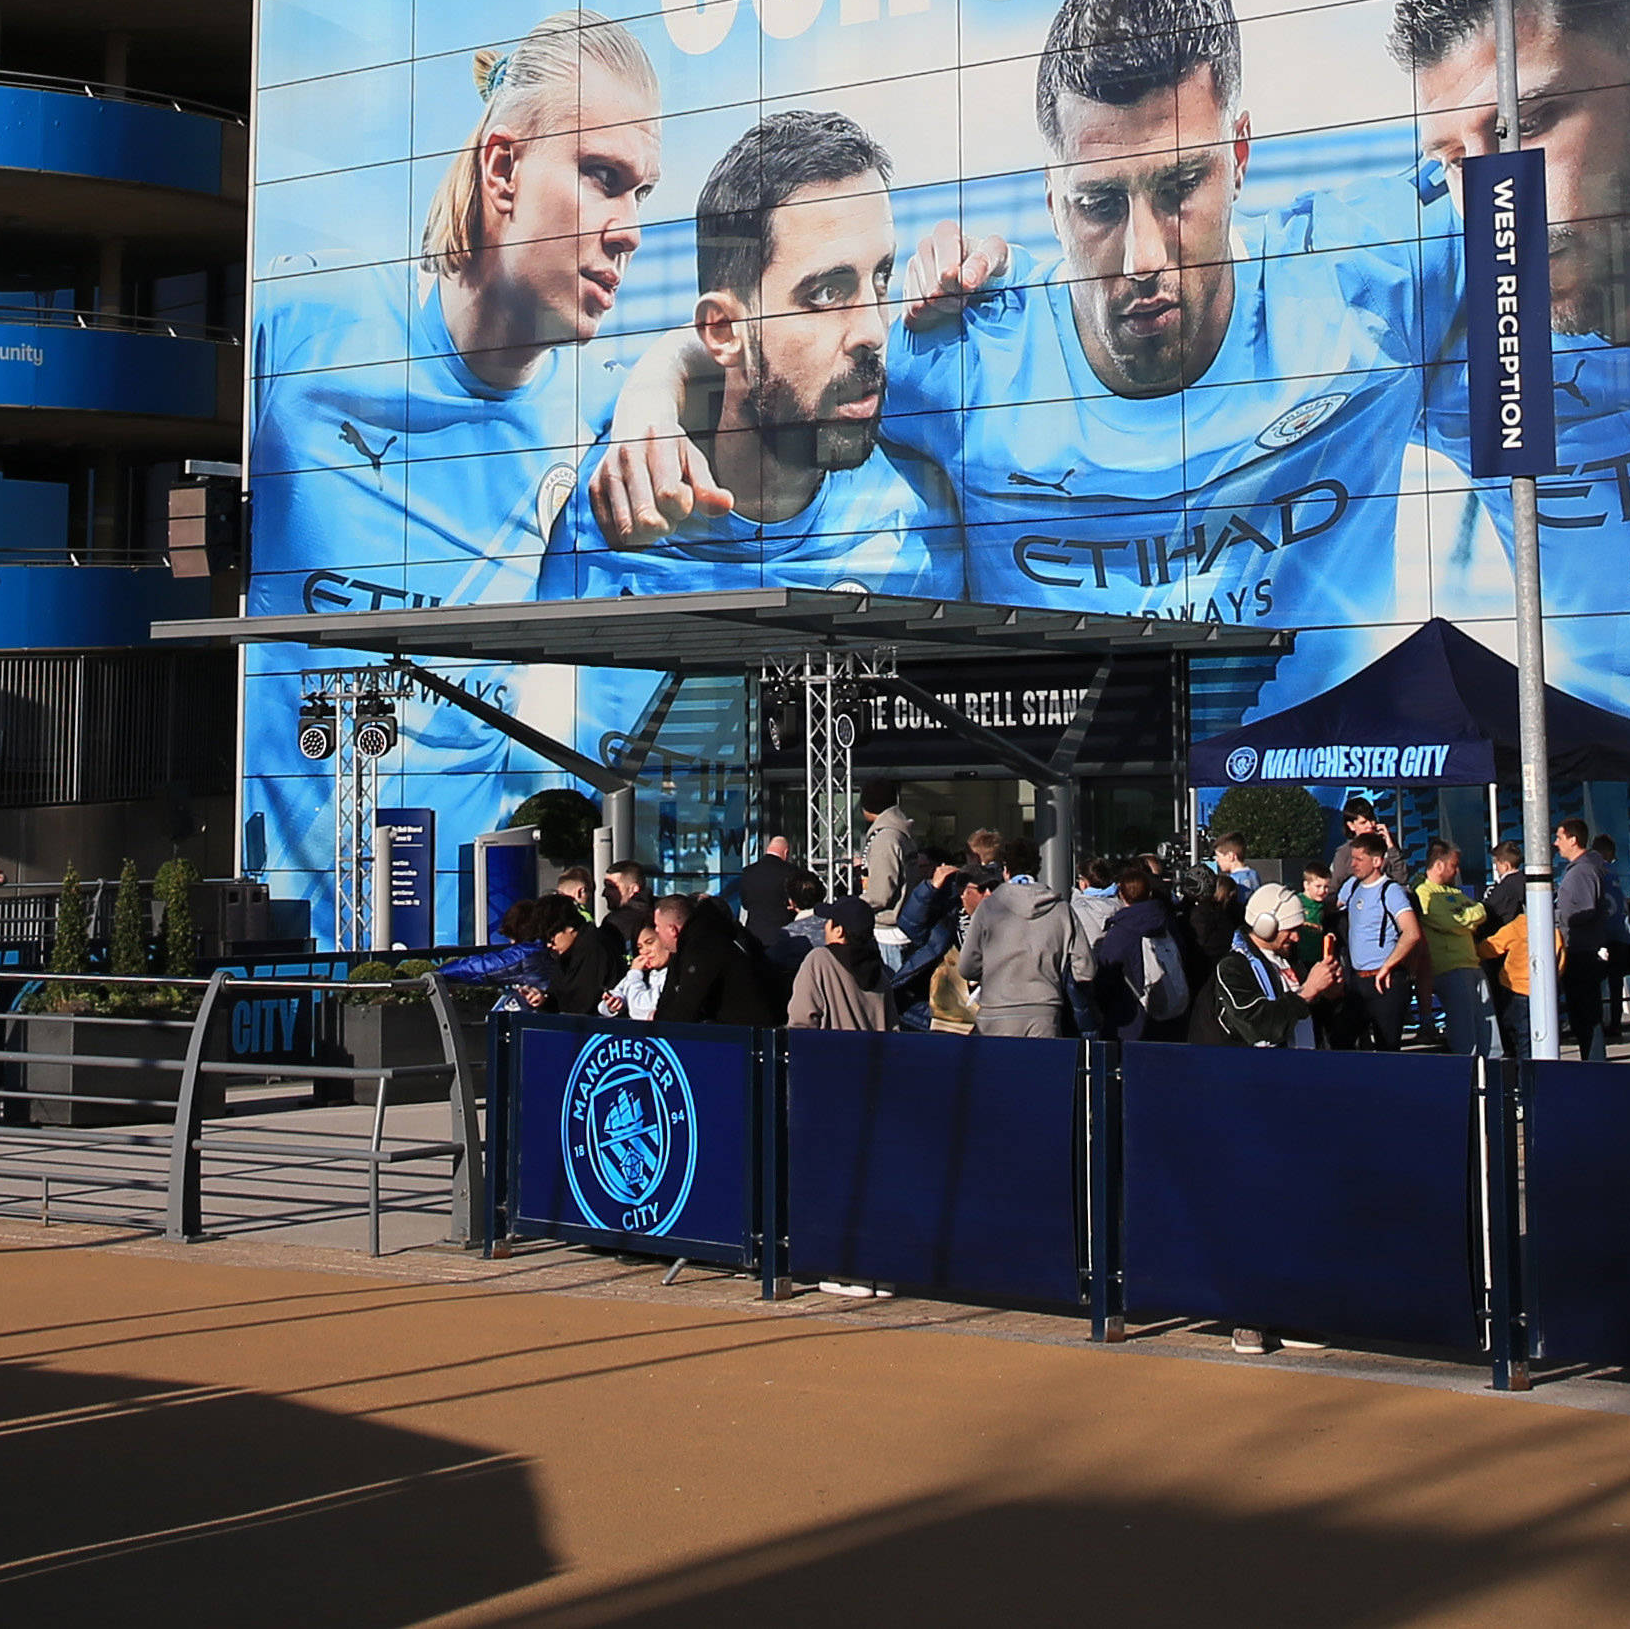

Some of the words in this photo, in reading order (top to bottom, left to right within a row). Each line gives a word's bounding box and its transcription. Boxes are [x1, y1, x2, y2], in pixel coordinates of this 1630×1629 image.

[1491, 177, 1516, 266] WEST
[1496, 275, 1523, 449] RECEPTION
[1012, 478, 1349, 588] ETIHAD
[965, 691, 1017, 728] BELL
[1260, 746, 1396, 780] MANCHESTER
[1399, 745, 1451, 777] CITY
[231, 998, 300, 1055] CITY
[573, 1039, 673, 1121] MANCHESTER
[574, 1144, 585, 1158] 18
[671, 1109, 685, 1125] 94
[622, 1201, 659, 1231] CITY
